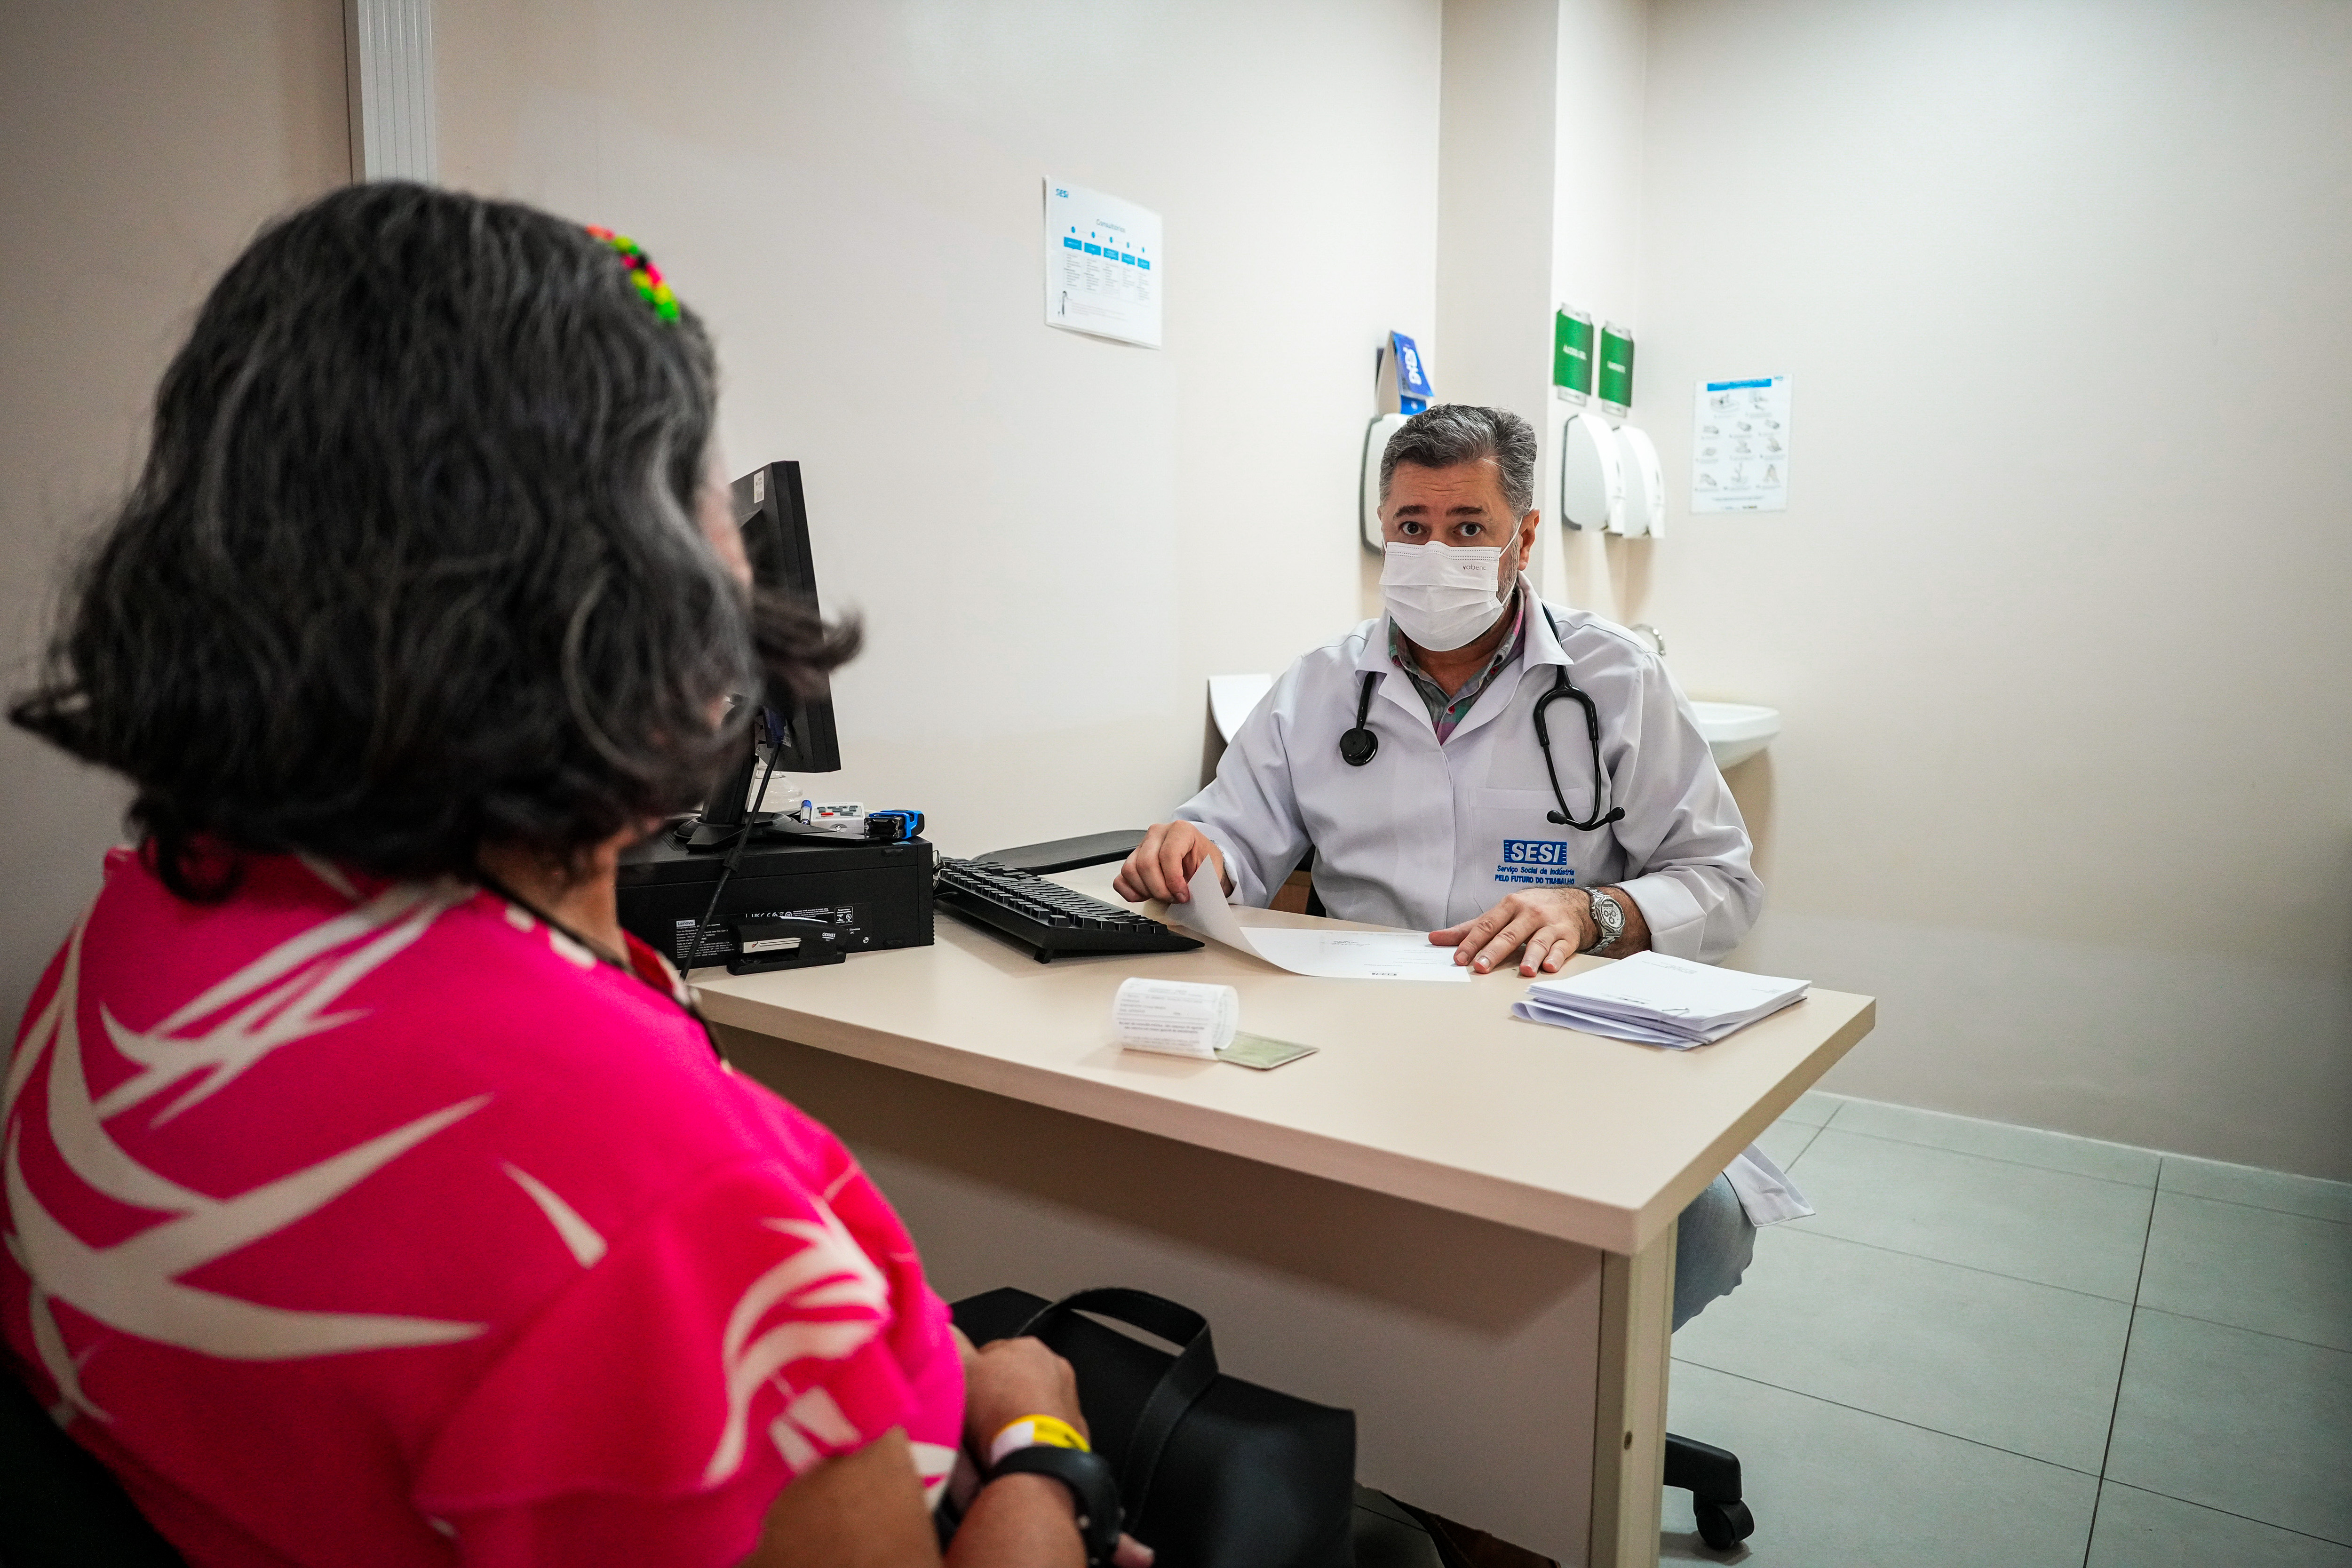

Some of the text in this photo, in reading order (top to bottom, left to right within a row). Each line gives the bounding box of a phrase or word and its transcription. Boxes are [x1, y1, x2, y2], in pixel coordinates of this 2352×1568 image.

[1510, 843, 1560, 863] SESI
[1497, 865, 1518, 874] Serviço
[1550, 867, 1574, 876] Indústria
